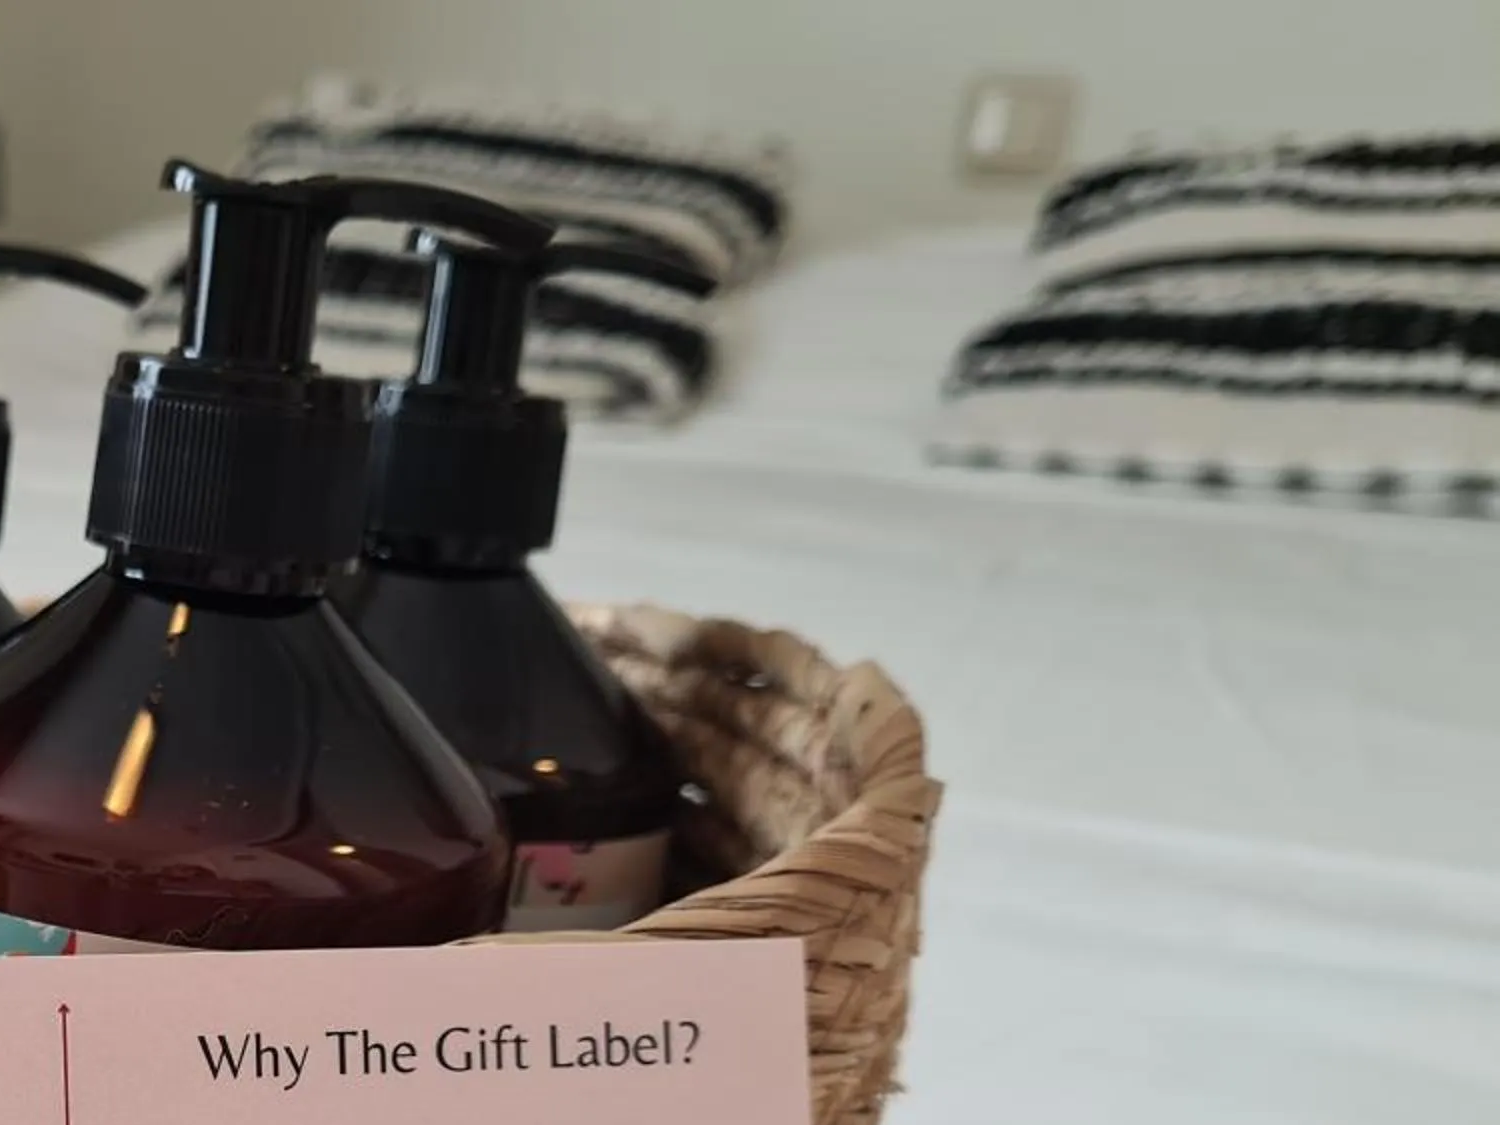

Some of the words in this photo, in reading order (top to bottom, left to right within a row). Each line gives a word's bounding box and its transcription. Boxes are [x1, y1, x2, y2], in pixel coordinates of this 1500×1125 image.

[196, 1031, 310, 1092] Why
[324, 1028, 418, 1076] The
[434, 1023, 531, 1073] Gift
[548, 1019, 701, 1069] Label?
